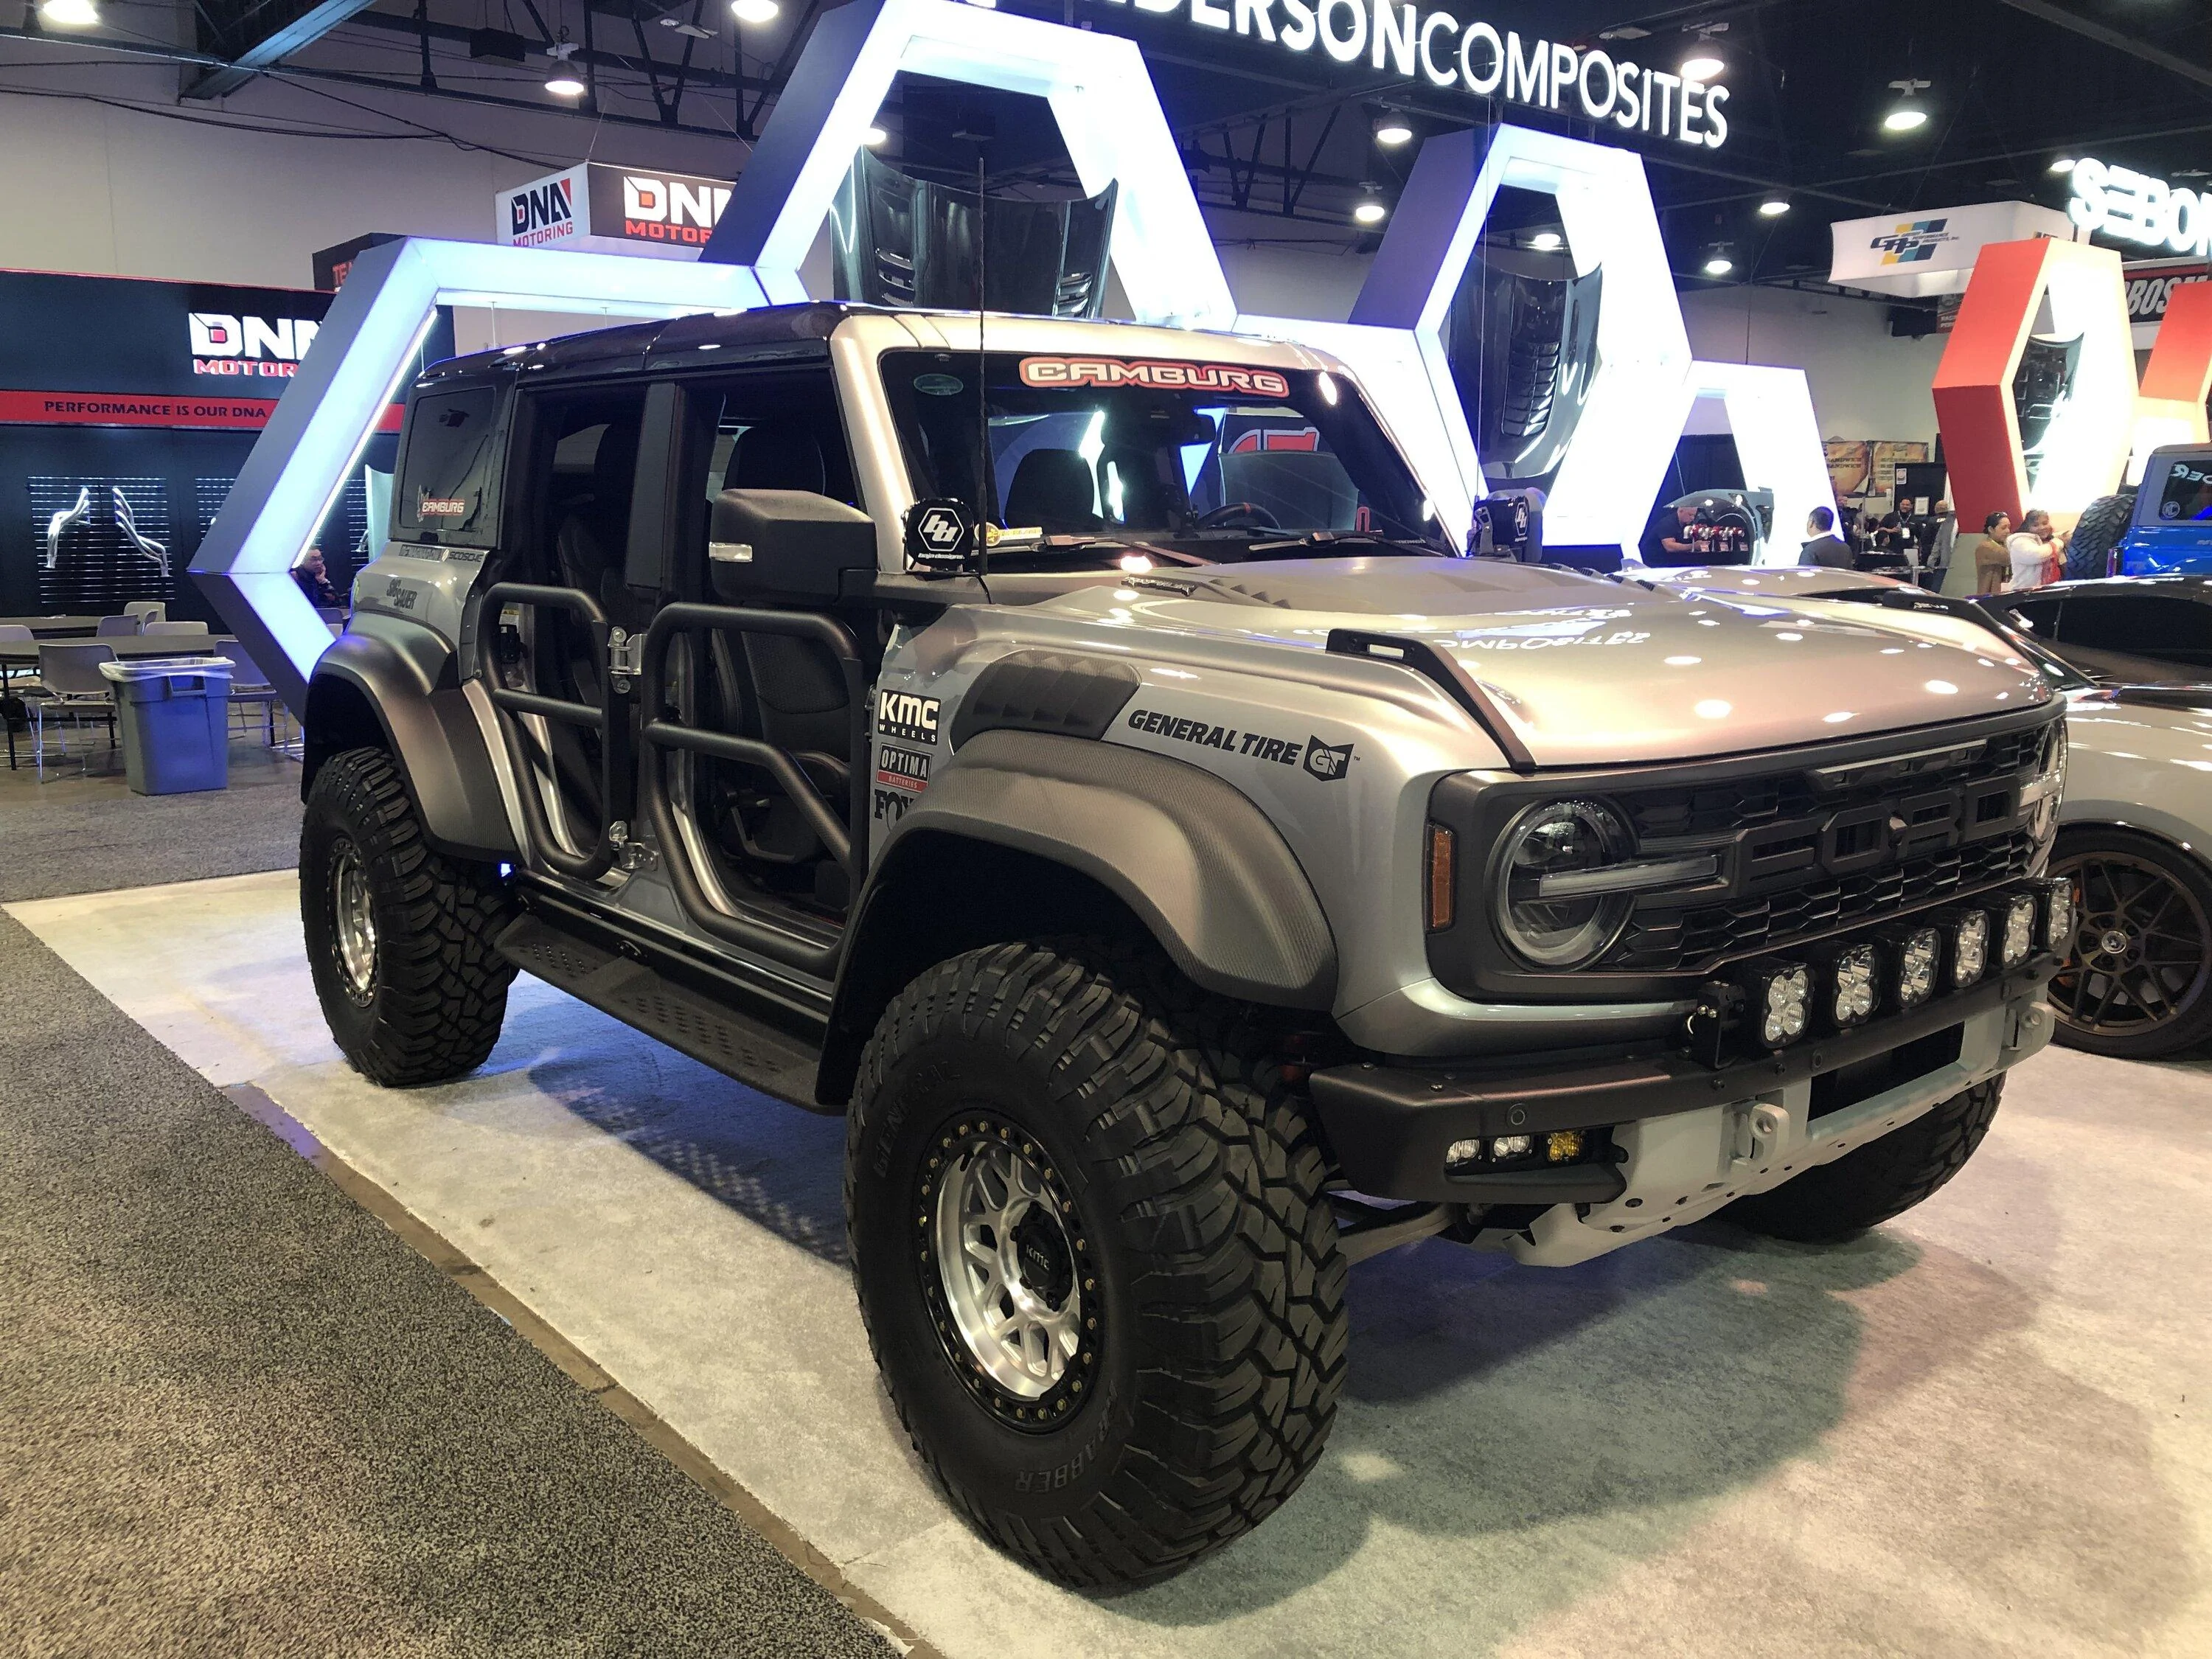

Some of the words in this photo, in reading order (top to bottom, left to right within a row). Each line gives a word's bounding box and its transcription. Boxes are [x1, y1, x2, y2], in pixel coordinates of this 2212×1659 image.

[511, 173, 571, 235] DNA
[513, 221, 573, 247] MOTORING
[1028, 361, 1284, 392] CAMBURG
[44, 400, 171, 416] PERFORMANCE
[176, 405, 189, 416] IS
[193, 406, 227, 417] OUR
[232, 406, 266, 418] DNA
[422, 501, 465, 513] CAMBURG
[879, 723, 936, 742] WHEELS
[1127, 709, 1237, 752] GENERAL
[1239, 732, 1304, 766] TIRE
[881, 749, 927, 778] OPTIMA
[888, 775, 917, 789] BATTERIES
